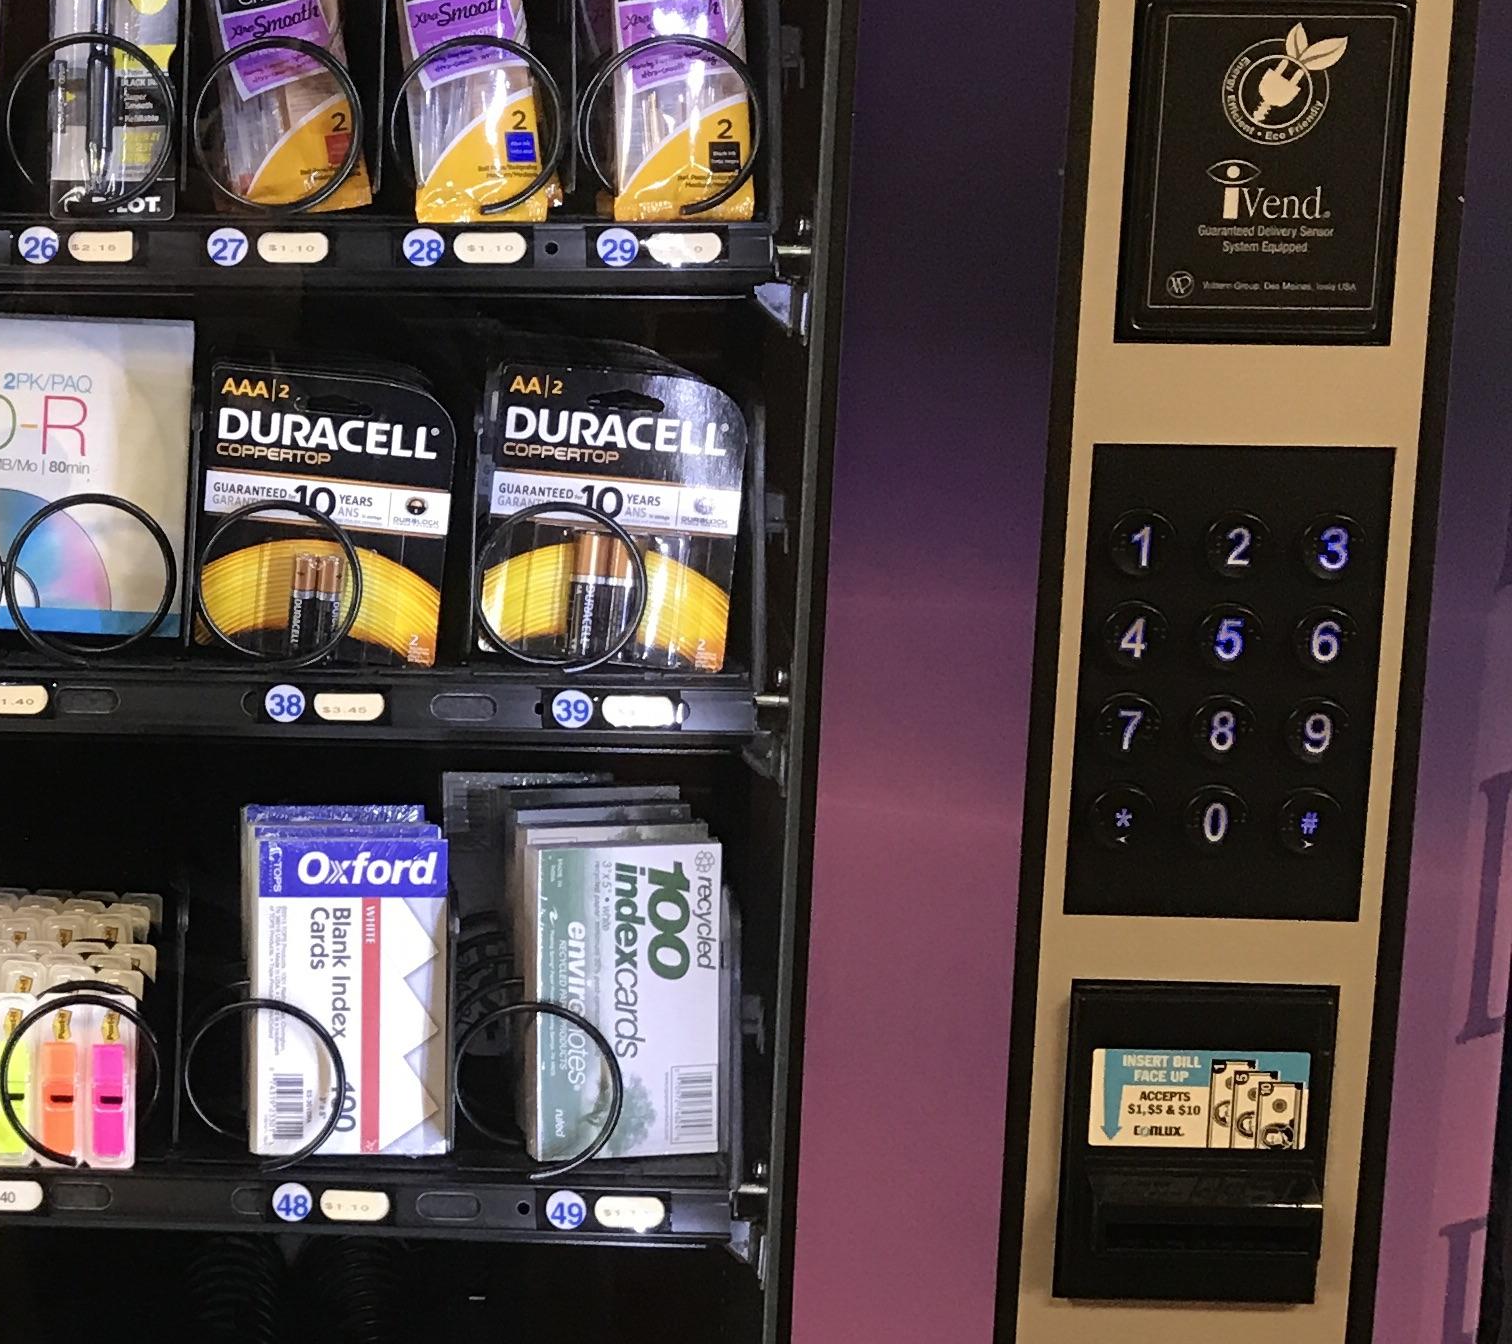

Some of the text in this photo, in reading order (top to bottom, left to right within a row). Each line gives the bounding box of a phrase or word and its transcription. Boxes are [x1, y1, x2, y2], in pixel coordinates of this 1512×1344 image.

[1257, 224, 1297, 239] Delivery
[1300, 225, 1334, 238] Sensor
[23, 236, 57, 259] 26
[212, 238, 245, 261] 27
[408, 238, 442, 262] 28
[601, 238, 639, 262] 29
[1222, 240, 1308, 255] System Equipped
[3, 373, 93, 394] 2PK/PAQ
[221, 377, 269, 399] AAA
[510, 374, 541, 396] AA
[217, 407, 438, 460] DURACELL
[505, 406, 727, 457] DURACELL
[216, 442, 331, 465] COPPERTOP
[503, 441, 619, 464] COPPERTOP
[1131, 526, 1351, 571] 1 2 3
[1120, 617, 1342, 663] 4 5 6
[269, 693, 302, 717] 38
[555, 699, 590, 723] 39
[1118, 709, 1332, 754] 7 8 9
[1203, 802, 1229, 843] 0
[297, 850, 435, 886] Oxford
[364, 905, 376, 944] WHITE
[647, 861, 691, 981] 100
[696, 875, 717, 970] recycled
[310, 906, 330, 971] Cards
[331, 907, 352, 1040] Blank Index
[1122, 1054, 1202, 1069] INSERT BILL
[1134, 1069, 1189, 1083] FACE UP
[1139, 1091, 1191, 1102] ACCEPTS
[1178, 1104, 1201, 1116] $10
[277, 1194, 309, 1218] 48
[551, 1202, 583, 1225] 49
